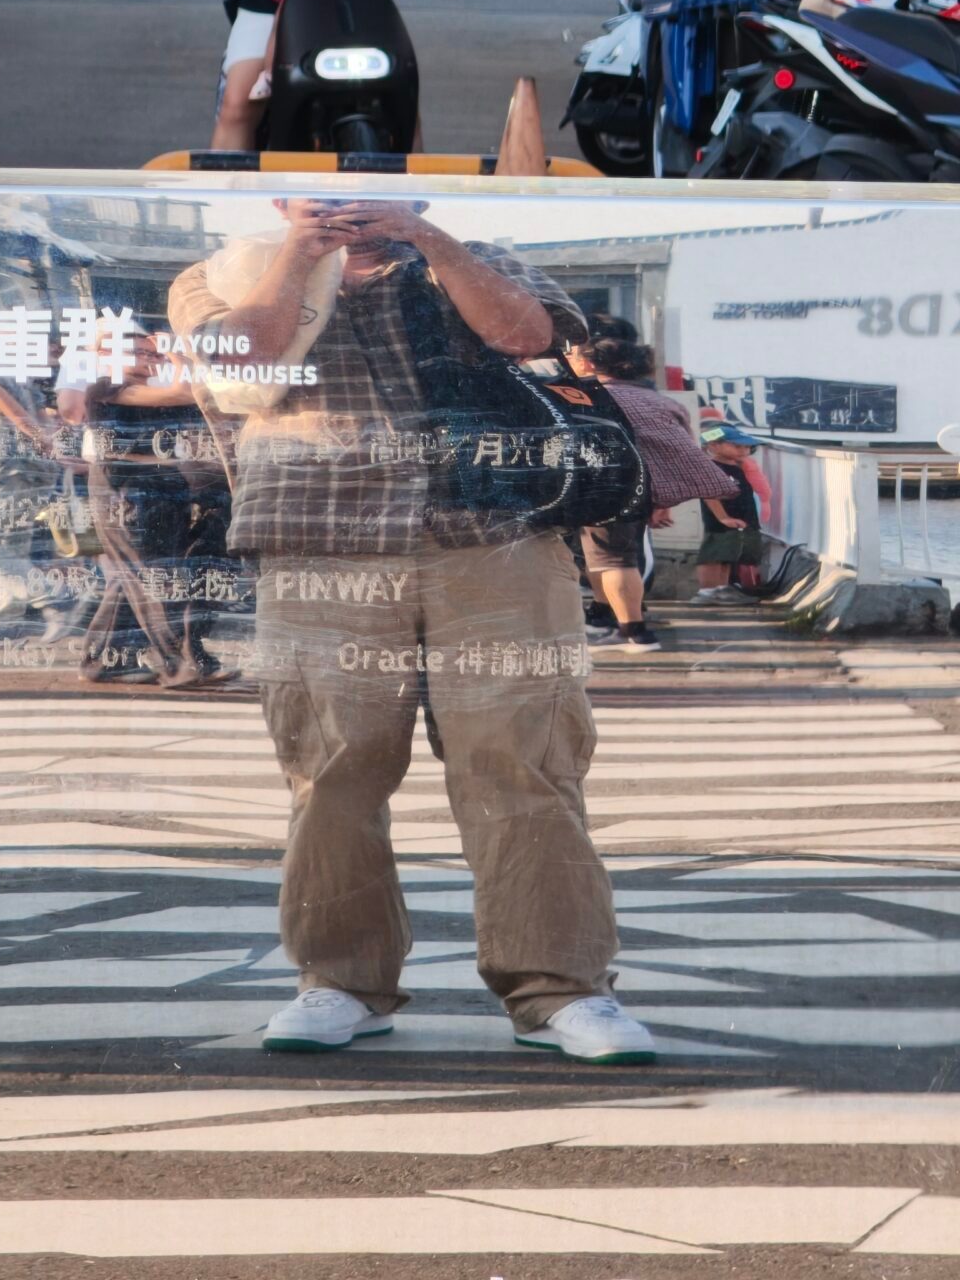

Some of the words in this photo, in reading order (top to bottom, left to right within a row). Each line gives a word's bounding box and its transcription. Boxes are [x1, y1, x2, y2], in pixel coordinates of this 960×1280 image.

[156, 335, 251, 355] DAYONG
[156, 365, 319, 385] WAREHOUSES
[339, 642, 444, 671] Oracle
